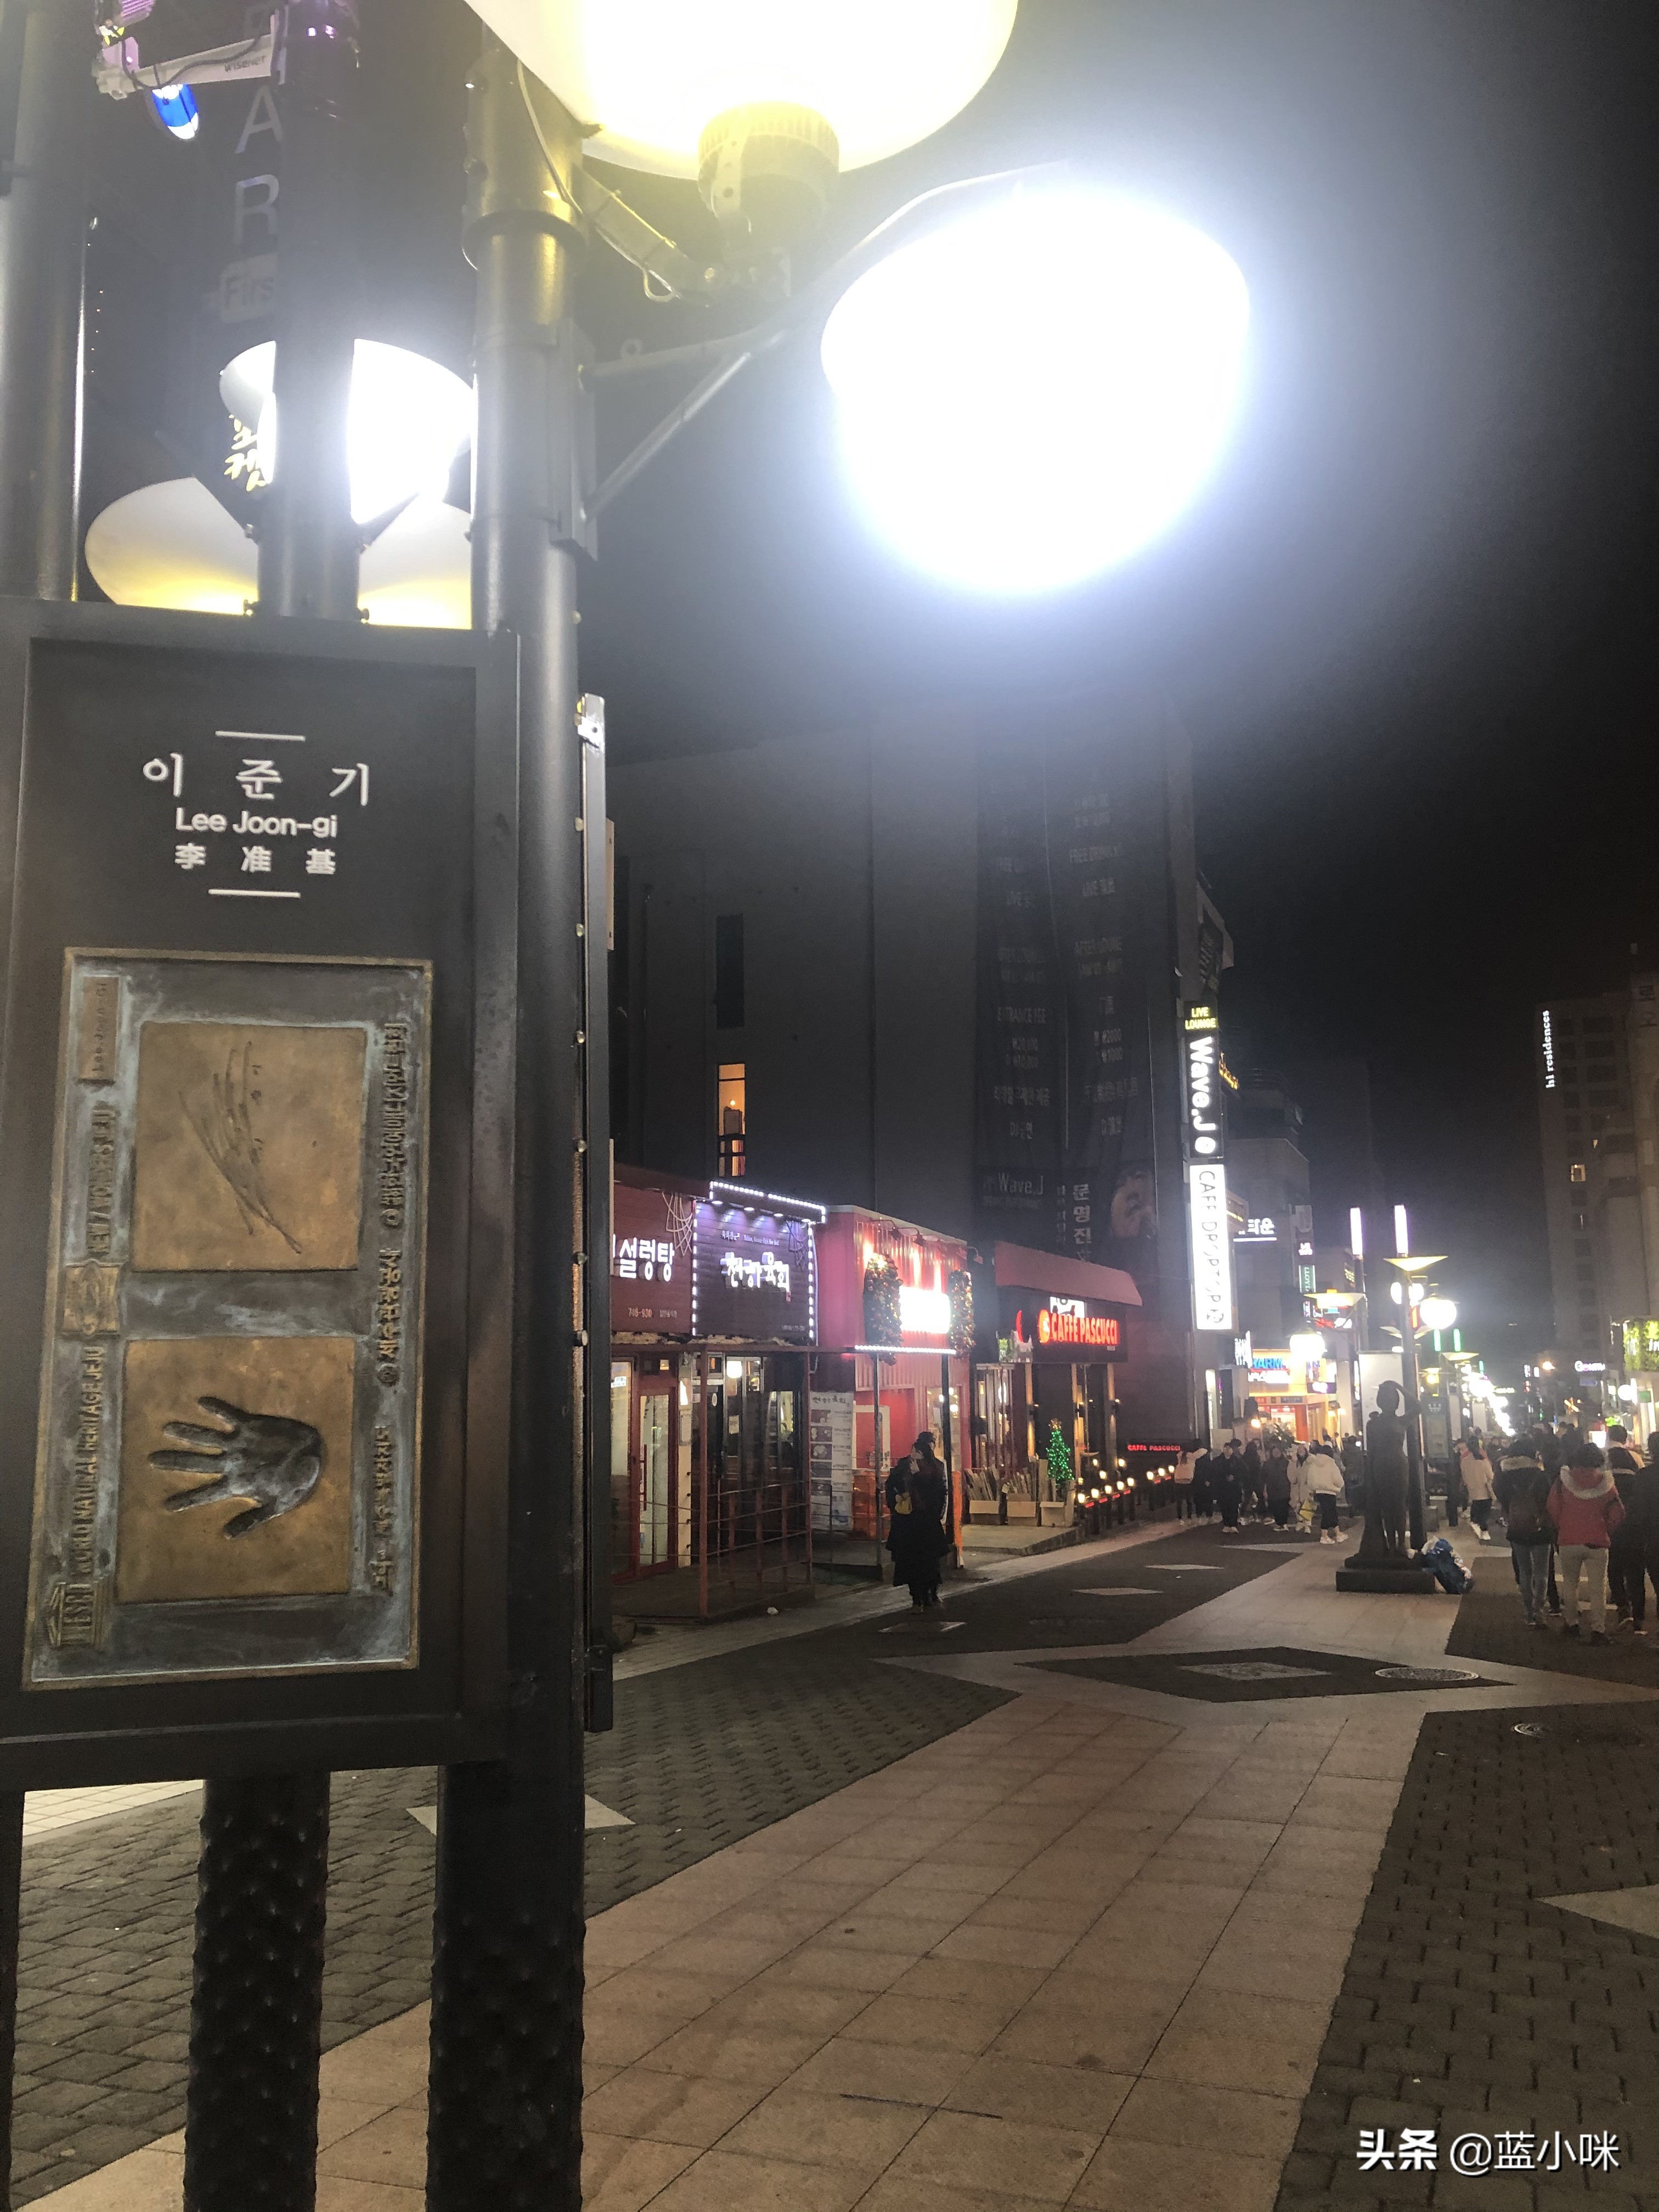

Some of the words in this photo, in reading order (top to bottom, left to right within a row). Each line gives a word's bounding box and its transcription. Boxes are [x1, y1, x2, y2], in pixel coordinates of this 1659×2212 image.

[176, 807, 227, 832] Lee
[233, 810, 338, 838] Joon-gi
[174, 842, 336, 876] 李准基
[1185, 1018, 1217, 1030] LOUNGE
[1191, 1007, 1209, 1018] LIVE
[1542, 1009, 1555, 1073] residences
[1545, 1074, 1556, 1089] hi
[1051, 1312, 1078, 1342] CAFFE
[1080, 1317, 1119, 1345] PASCUCCI
